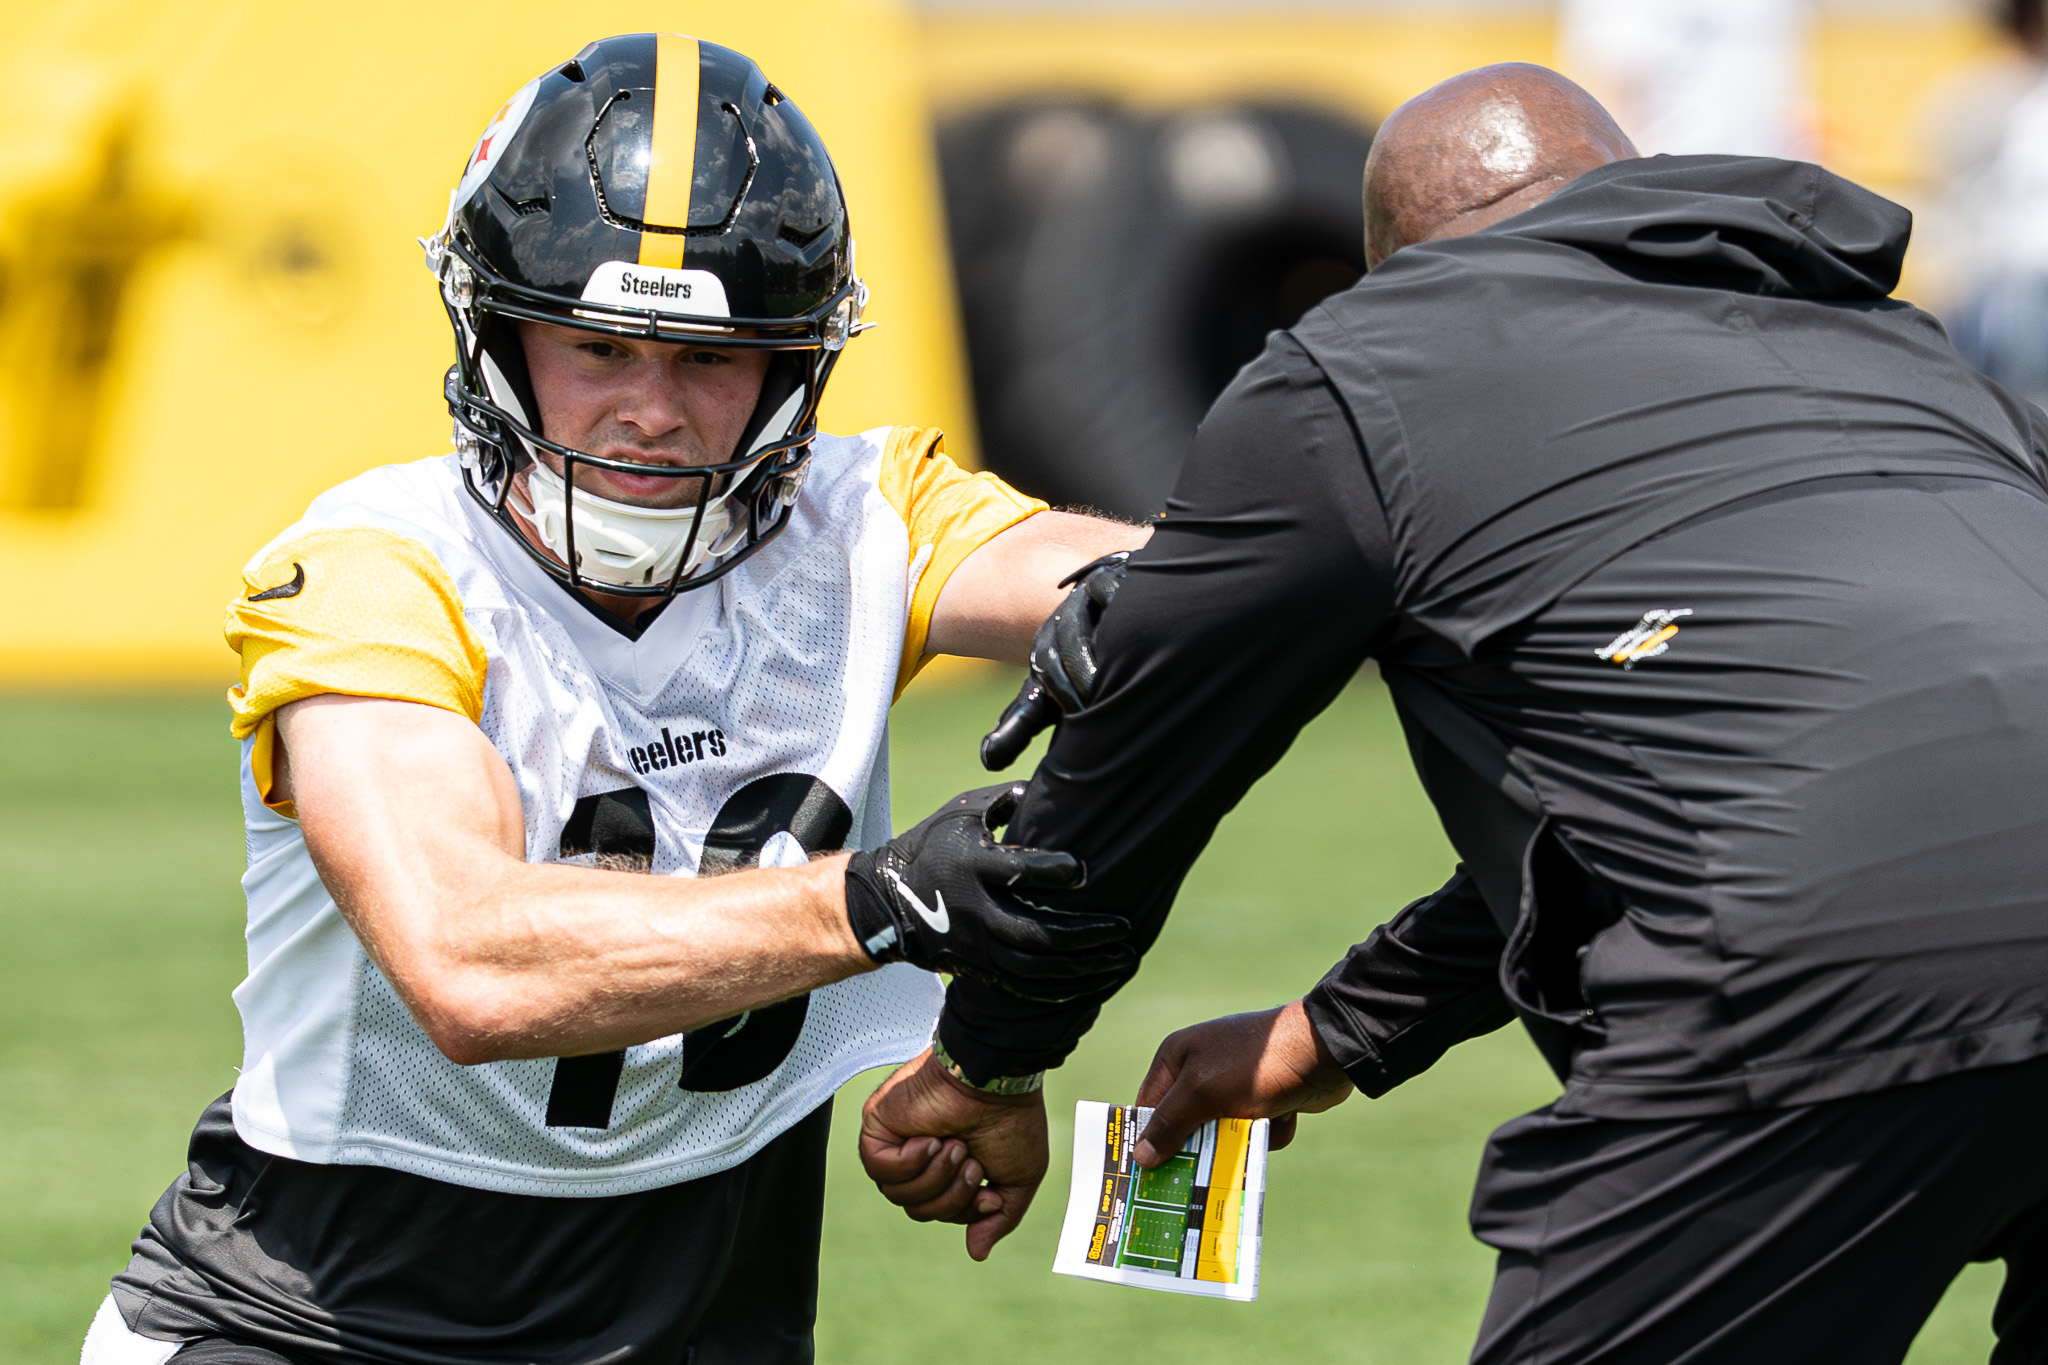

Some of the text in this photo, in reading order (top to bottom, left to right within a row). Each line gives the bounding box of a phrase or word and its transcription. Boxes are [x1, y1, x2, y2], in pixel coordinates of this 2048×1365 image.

[621, 272, 692, 299] Steelers
[626, 727, 727, 775] eelers
[1088, 1225, 1106, 1259] Steelers
